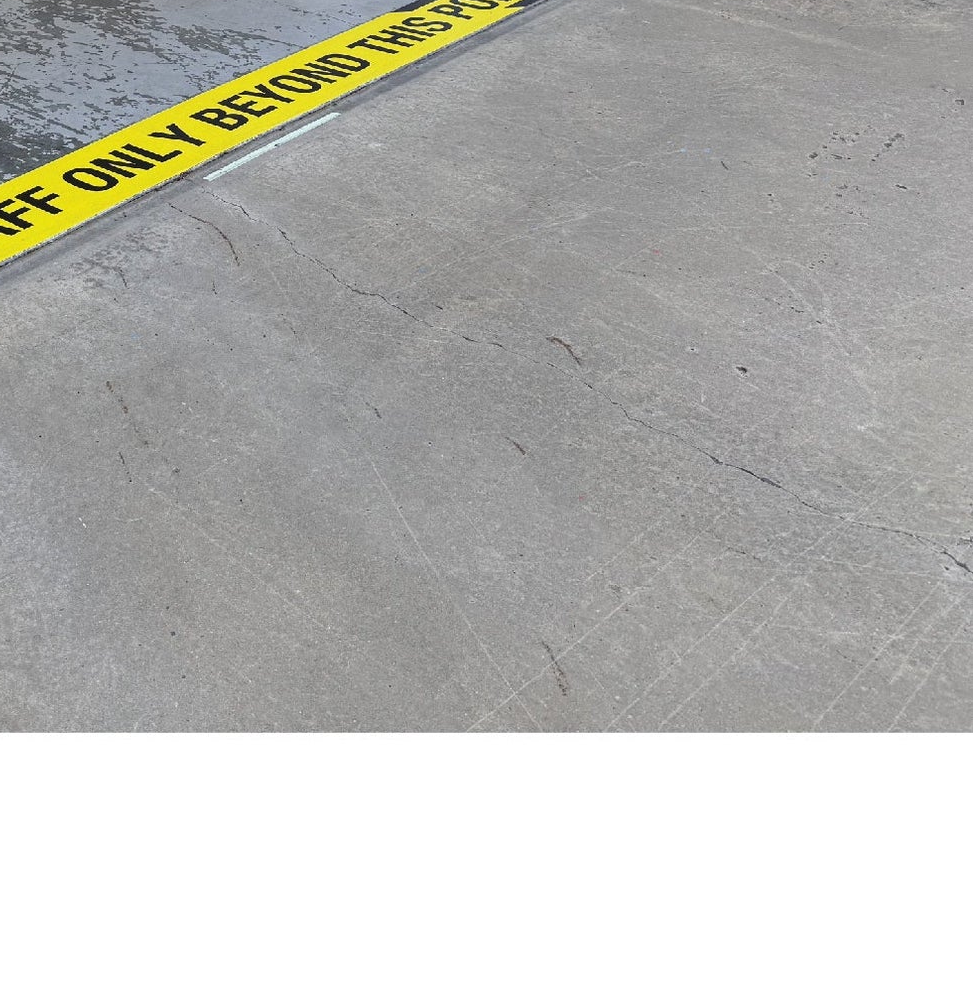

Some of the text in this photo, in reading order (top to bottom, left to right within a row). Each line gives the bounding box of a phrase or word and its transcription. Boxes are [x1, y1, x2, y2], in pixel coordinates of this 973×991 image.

[62, 123, 205, 192] ONLY
[190, 53, 371, 131] BEYOND
[347, 16, 453, 54] THIS
